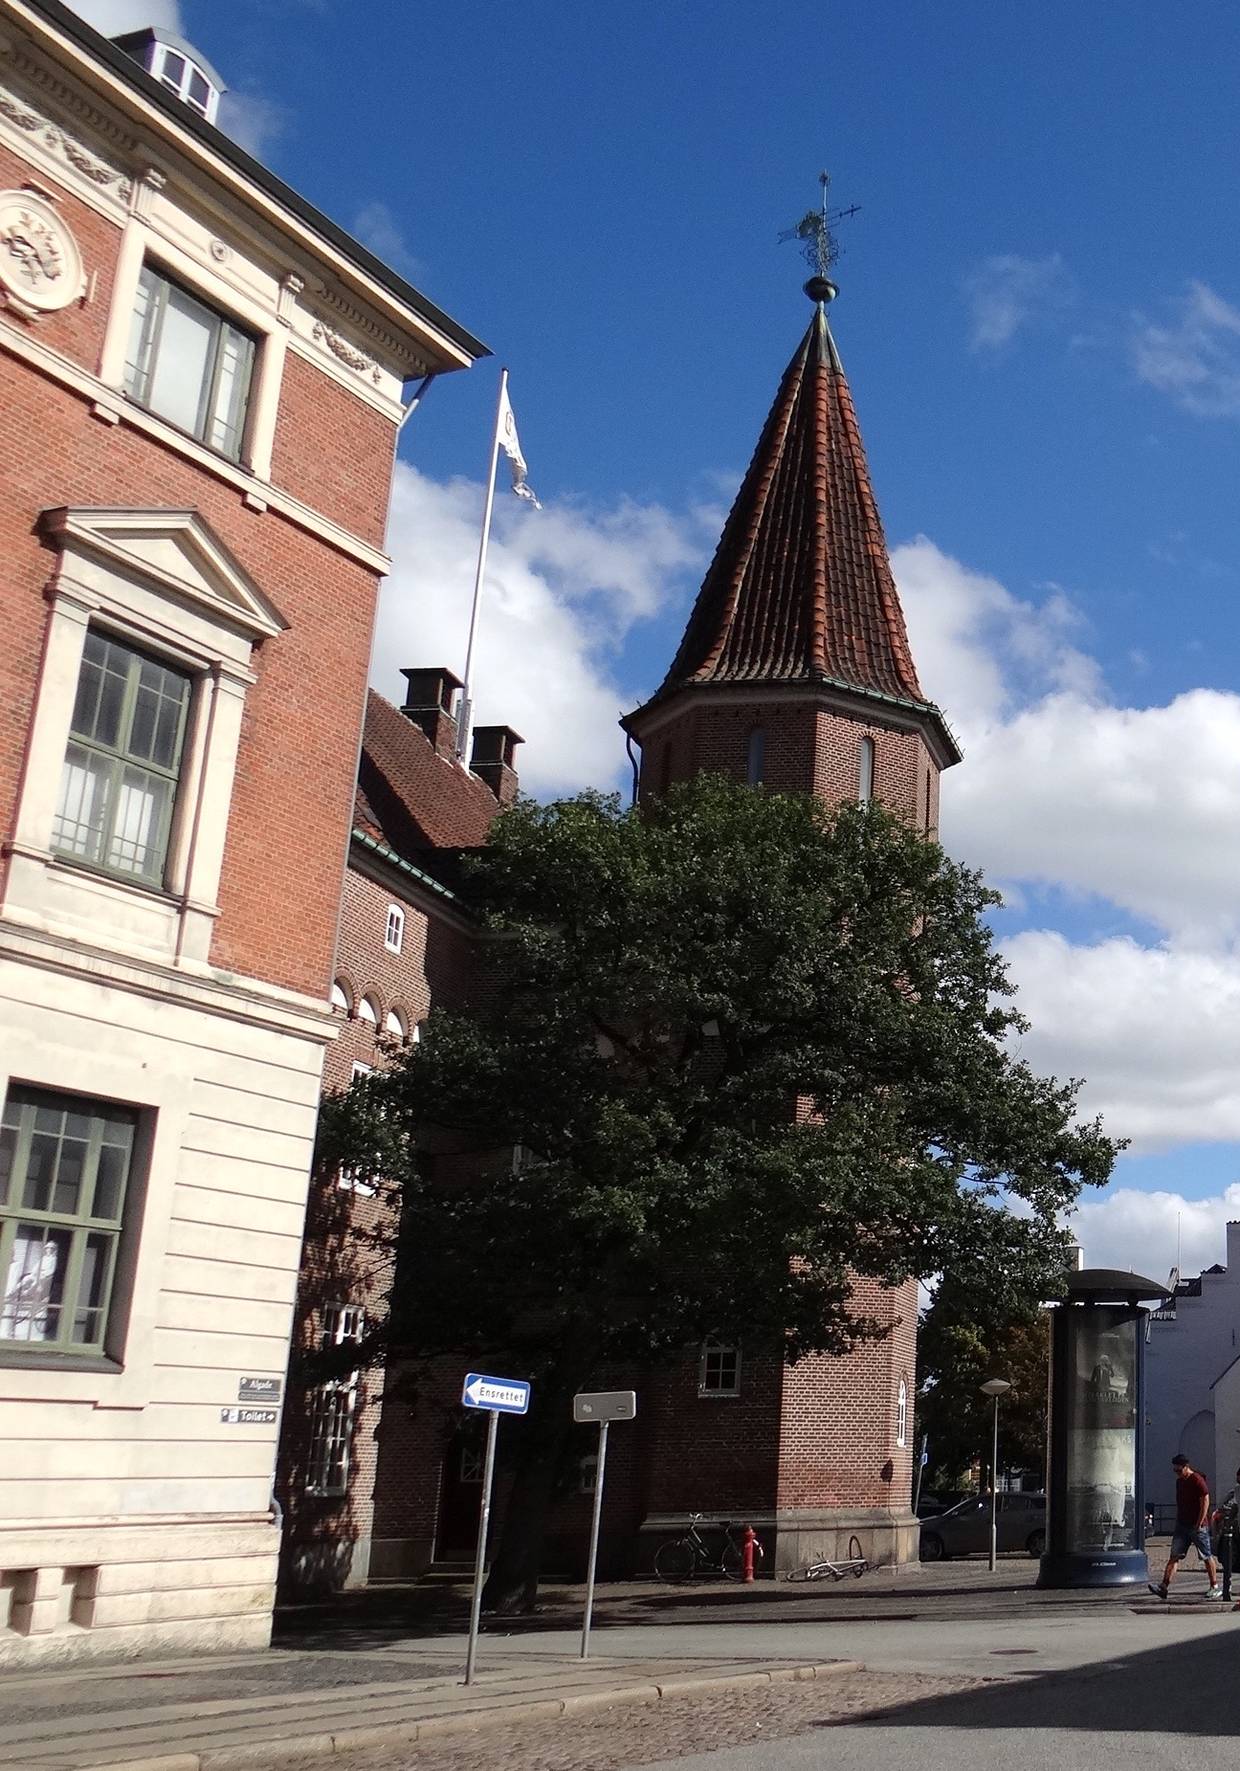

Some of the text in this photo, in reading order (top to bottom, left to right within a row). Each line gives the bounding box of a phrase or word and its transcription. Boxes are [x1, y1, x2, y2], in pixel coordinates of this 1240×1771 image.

[249, 1380, 272, 1390] Algade
[480, 1387, 523, 1403] Ensrettet
[241, 1411, 267, 1421] Toilet
